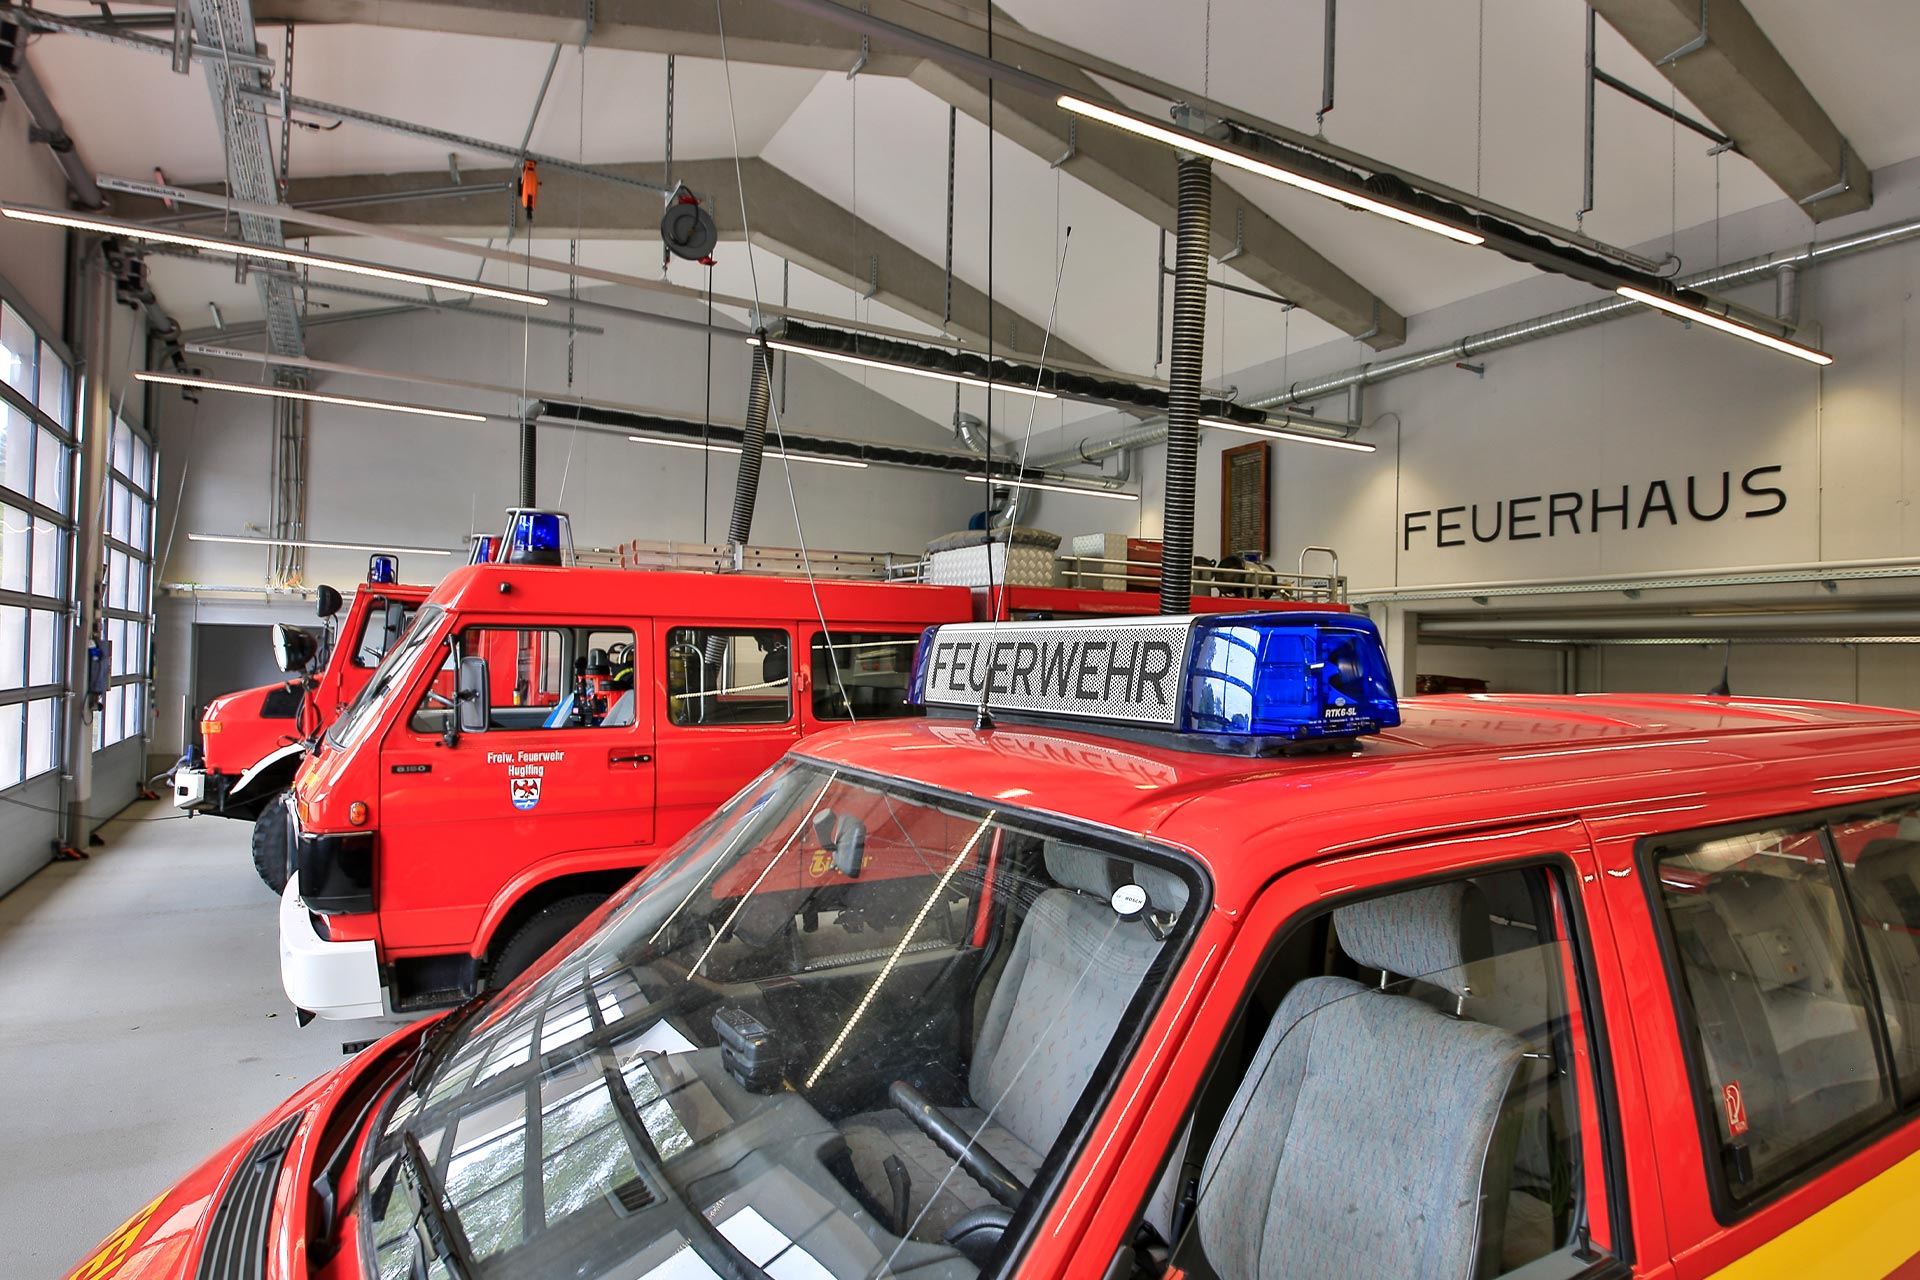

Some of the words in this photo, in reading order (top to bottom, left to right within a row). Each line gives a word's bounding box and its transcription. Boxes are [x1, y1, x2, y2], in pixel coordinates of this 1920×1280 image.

[1404, 465, 1787, 551] FEUERHAUS
[931, 641, 1173, 705] FEUERWEHR
[487, 751, 515, 764] Freiw.
[518, 749, 565, 763] Feuerwehr
[508, 764, 544, 777] Huglfing
